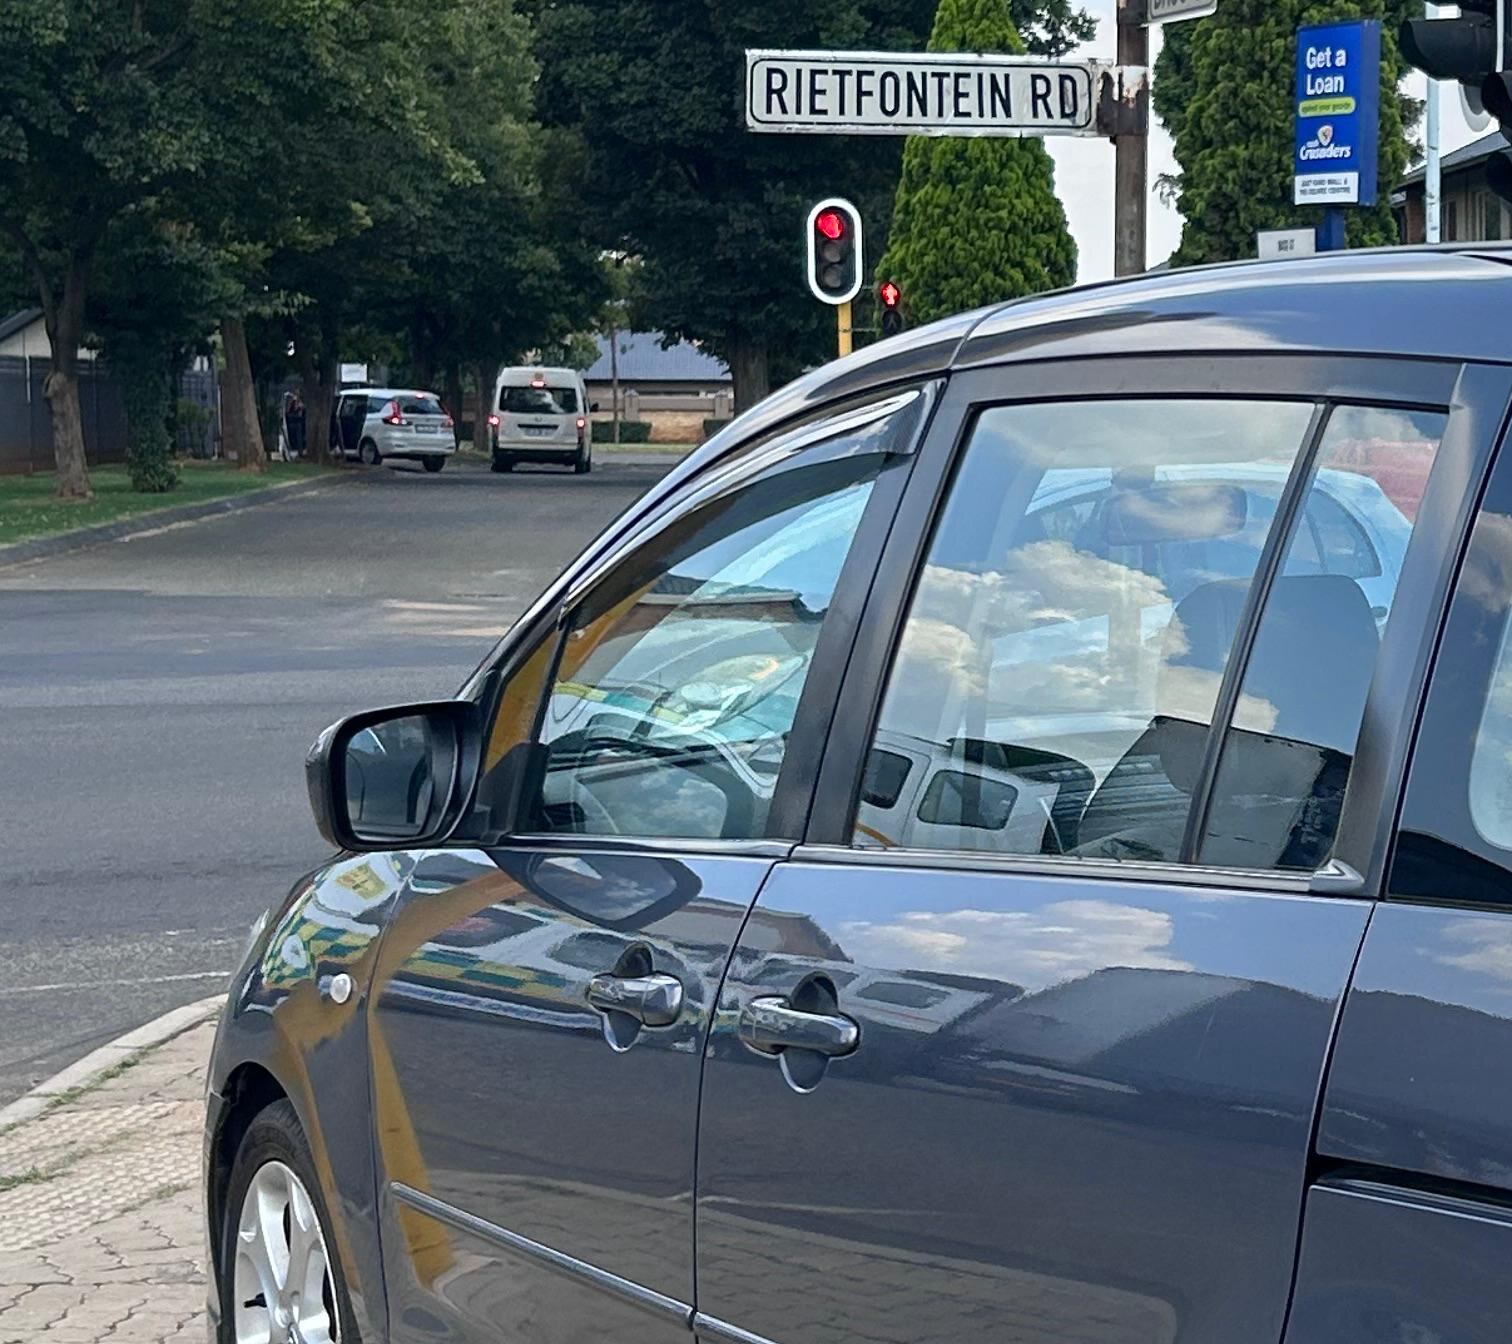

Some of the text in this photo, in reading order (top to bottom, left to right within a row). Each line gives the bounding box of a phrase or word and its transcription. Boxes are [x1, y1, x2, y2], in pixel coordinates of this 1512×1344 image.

[1306, 46, 1347, 69] Get a
[765, 67, 1078, 119] RIETFONTEIN RD
[1306, 74, 1345, 95] Loan
